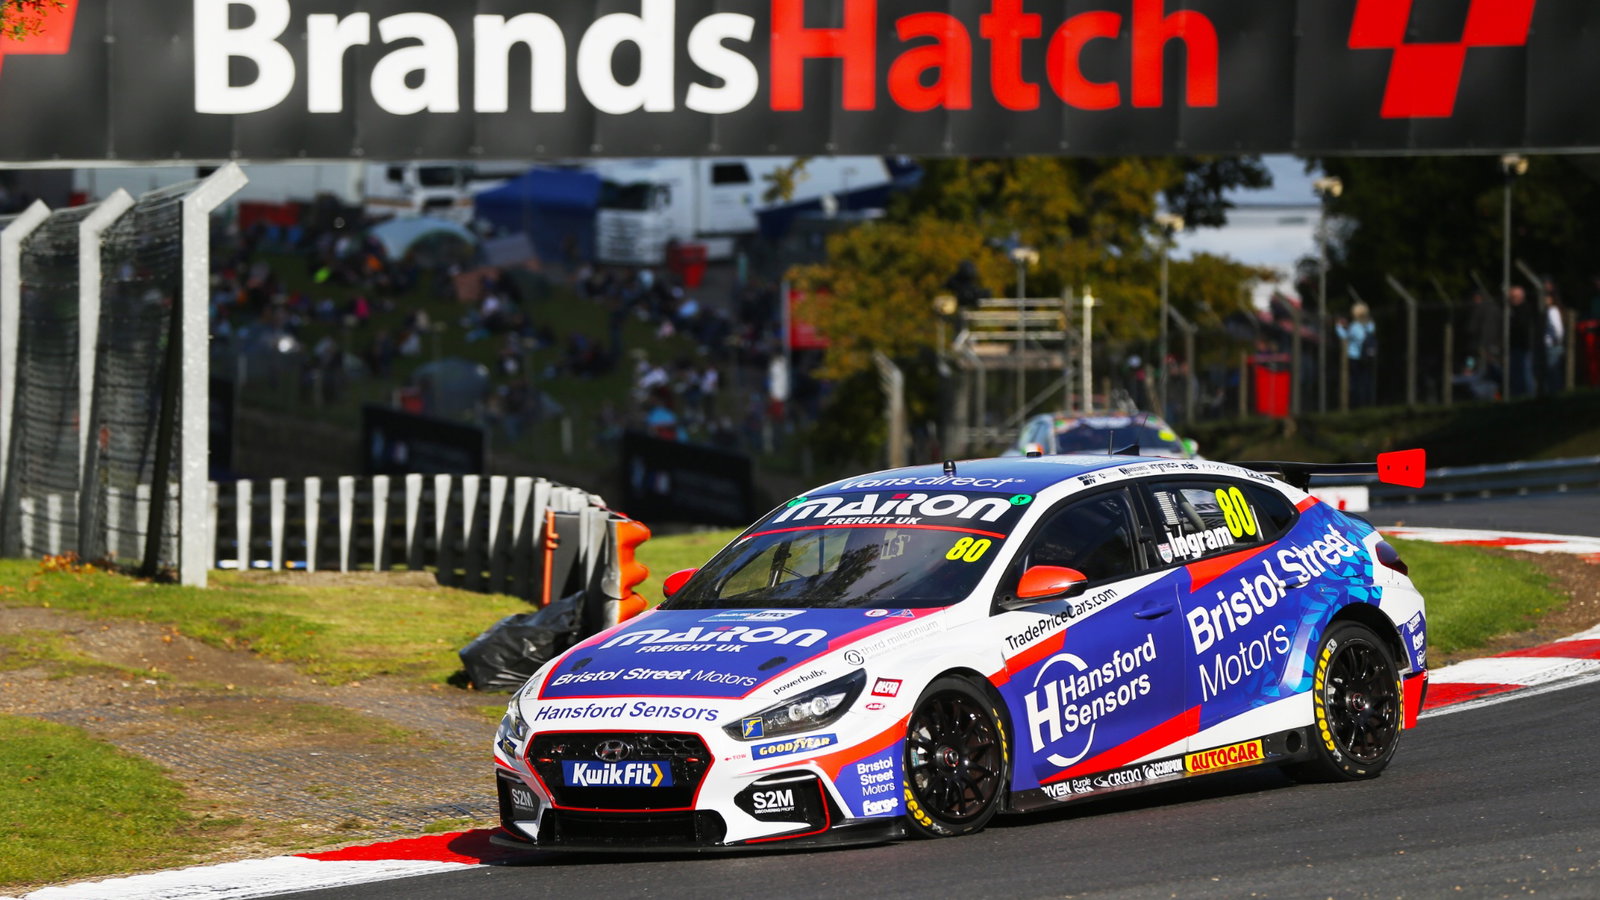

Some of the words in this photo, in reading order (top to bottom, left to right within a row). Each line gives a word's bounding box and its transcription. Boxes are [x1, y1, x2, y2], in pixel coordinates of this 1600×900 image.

[824, 517, 894, 525] FREIGHT
[895, 517, 922, 525] UK
[1214, 486, 1257, 538] 80
[945, 536, 992, 563] 80
[1166, 525, 1235, 559] Ingram
[1186, 559, 1288, 656] Bristol
[1276, 523, 1360, 589] Street
[1005, 586, 1118, 651] TradePriceCars.com
[636, 643, 716, 653] FREIGHT
[716, 643, 749, 653] UK
[1059, 633, 1157, 706] Hansford
[1198, 624, 1290, 702] Motors
[551, 668, 626, 687] Bristol
[623, 667, 691, 680] Street
[690, 670, 758, 687] Motors
[773, 669, 828, 695] powerbulbs
[534, 702, 627, 722] Hansford
[629, 701, 719, 721] Sensors
[1064, 674, 1151, 733] Sensors
[857, 757, 894, 775] Bristol
[1191, 742, 1260, 771] AUTOCAR
[860, 770, 894, 786] Street
[1107, 768, 1142, 787] CREDO
[511, 788, 534, 808] S2M
[753, 789, 795, 809] S2M
[862, 783, 896, 796] Motors
